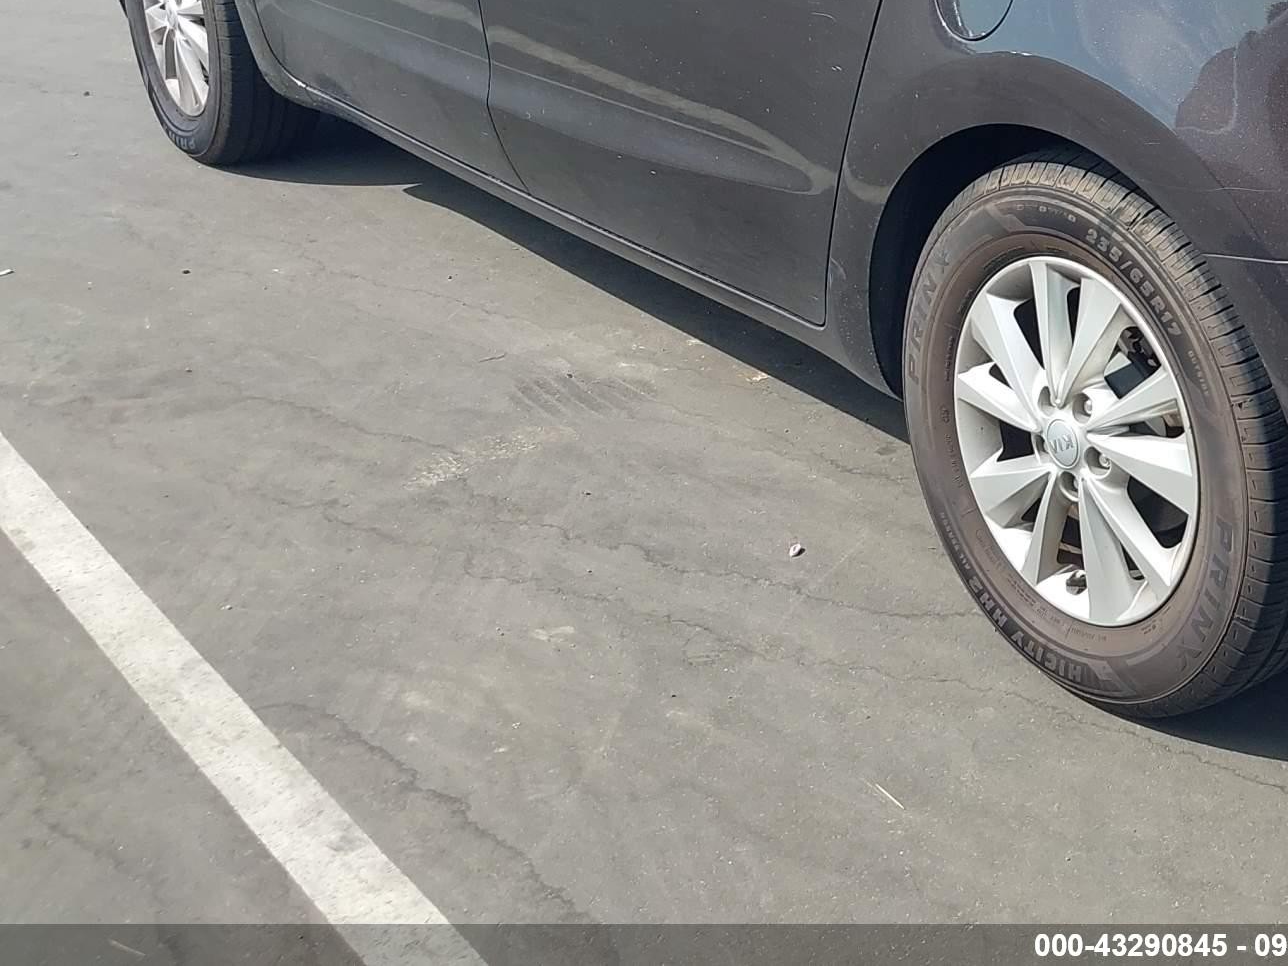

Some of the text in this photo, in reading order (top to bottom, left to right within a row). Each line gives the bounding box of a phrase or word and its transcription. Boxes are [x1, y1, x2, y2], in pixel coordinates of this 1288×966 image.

[1085, 228, 1182, 335] 235/65R17
[968, 576, 1009, 628] HH2
[1010, 631, 1082, 681] HICITY
